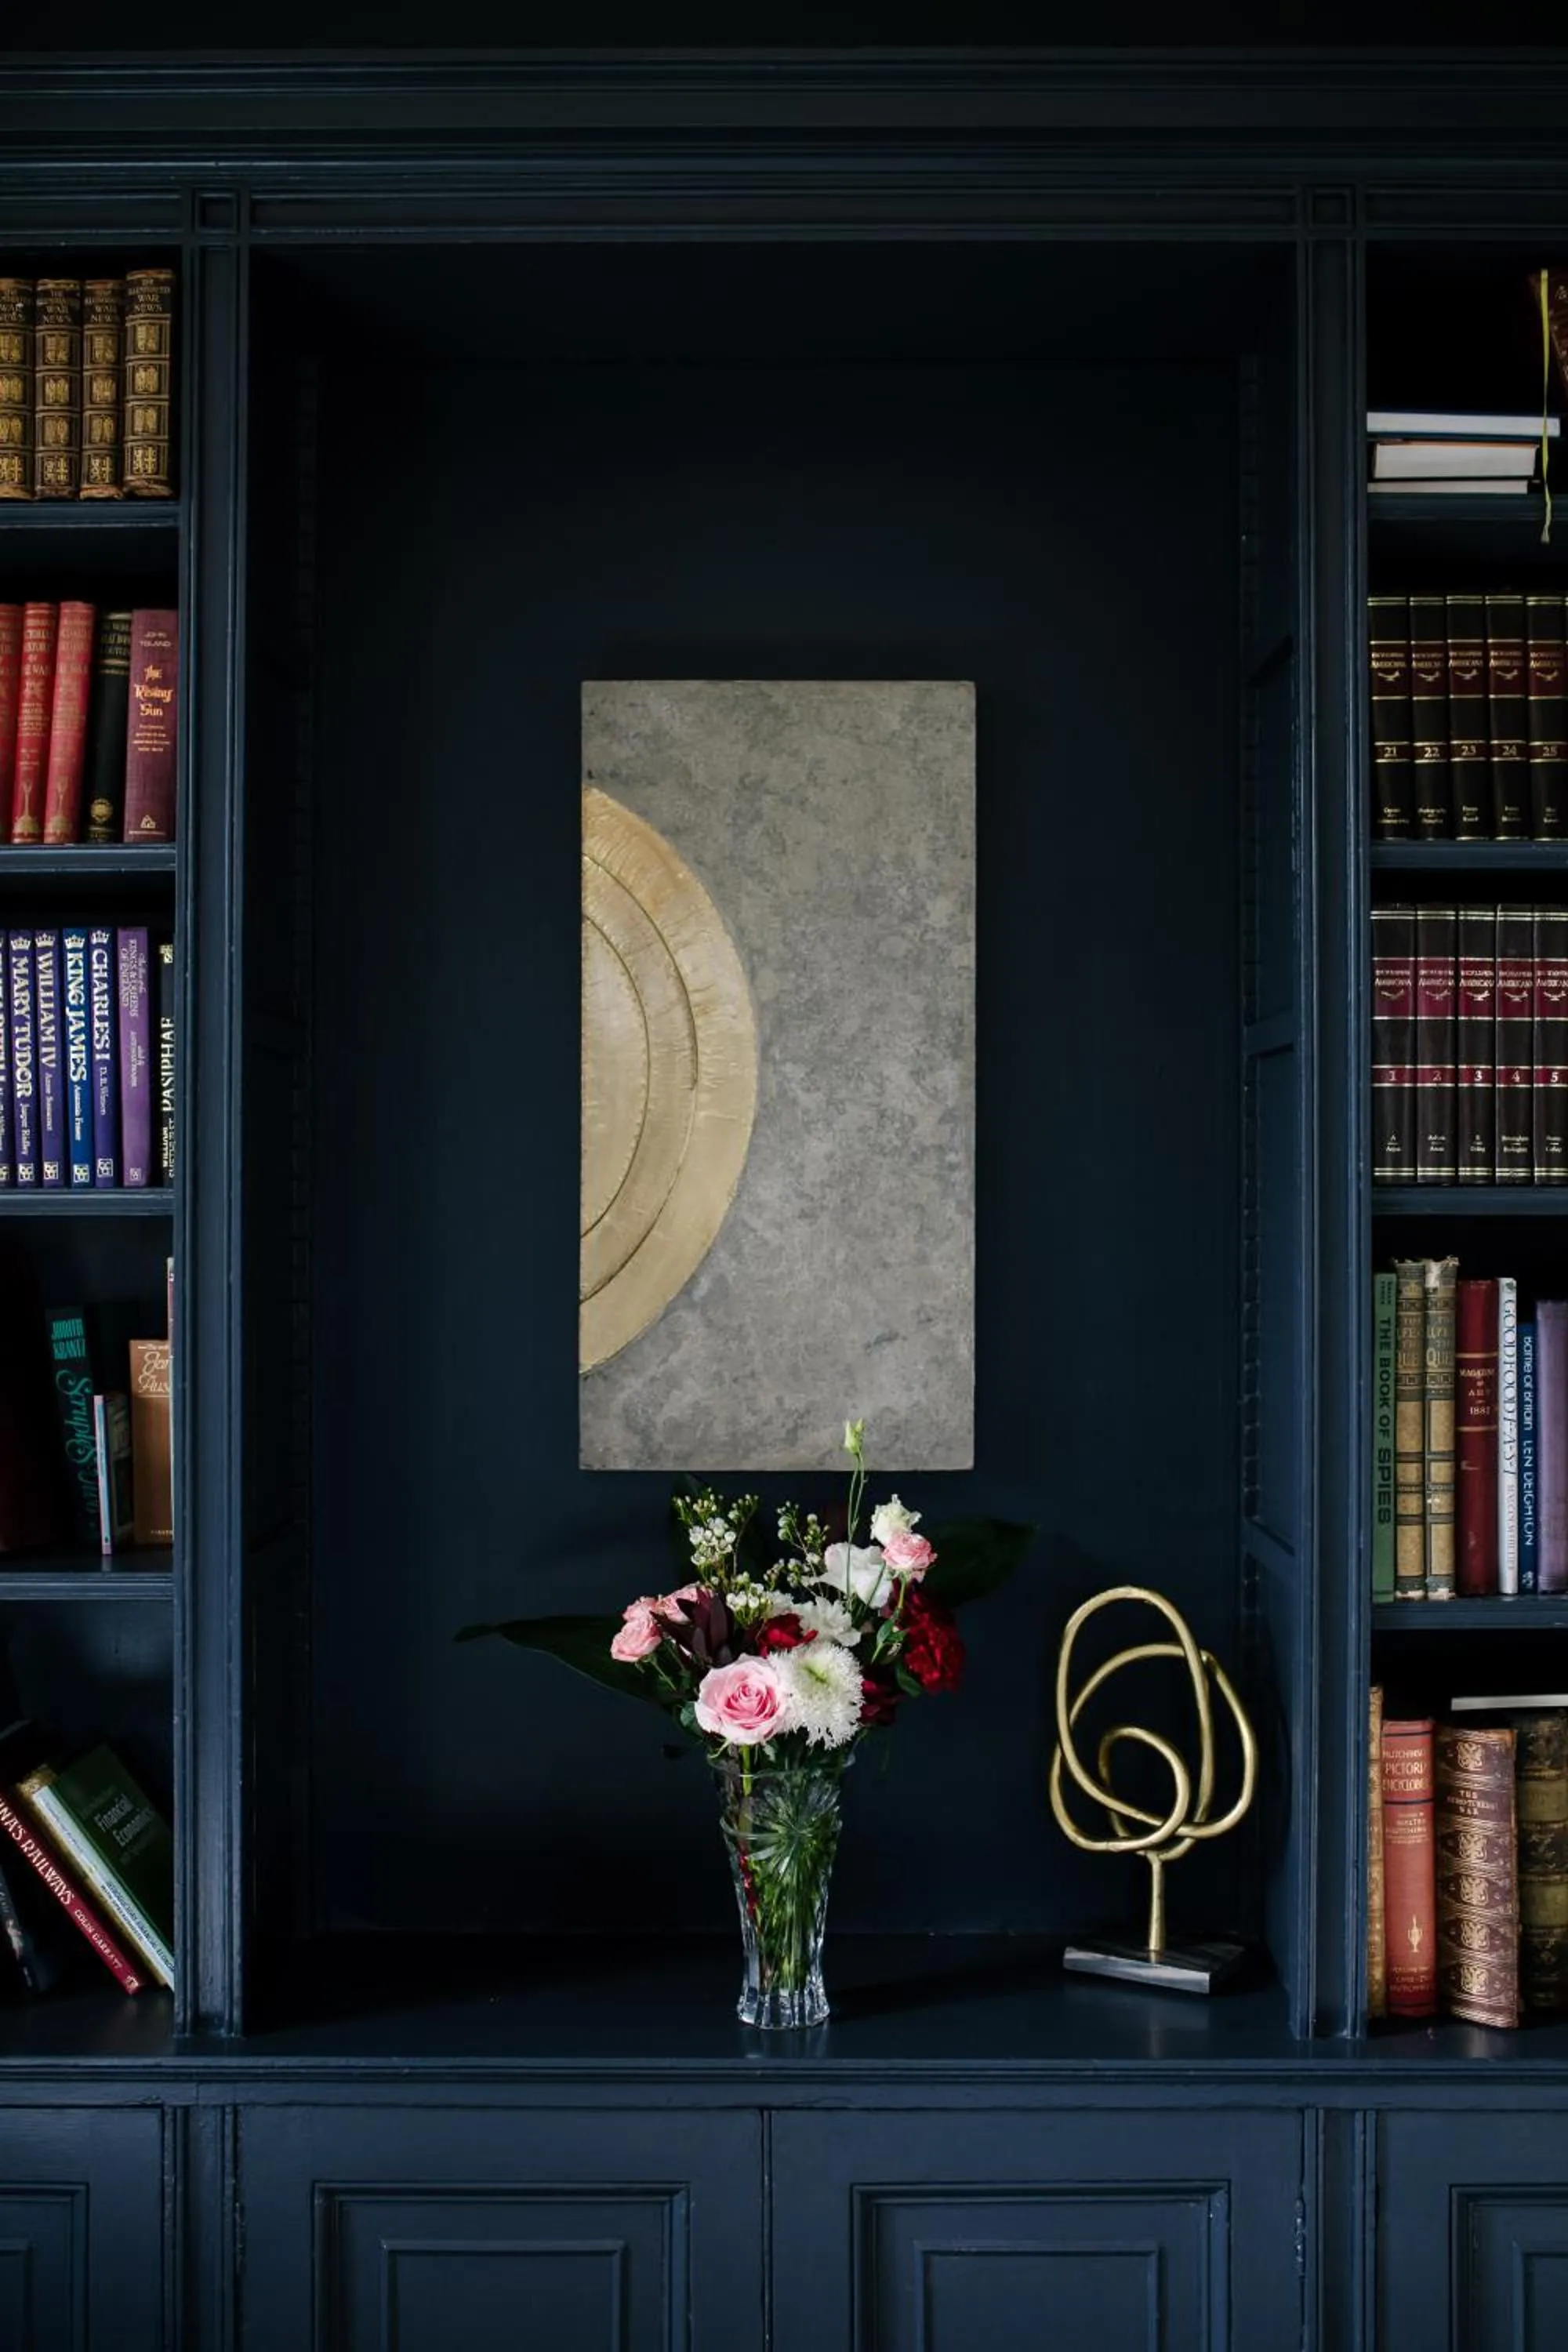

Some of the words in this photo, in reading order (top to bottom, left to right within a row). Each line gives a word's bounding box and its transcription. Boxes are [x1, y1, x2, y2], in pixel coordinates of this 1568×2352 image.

[133, 303, 162, 313] NEWS
[144, 630, 167, 639] JOHN
[134, 684, 173, 703] Rising
[140, 703, 163, 717] Sun
[1384, 746, 1397, 758] 21
[1424, 747, 1440, 758] 22
[1461, 745, 1476, 756] 23
[1501, 746, 1517, 757] 24
[1543, 746, 1557, 757] 25
[12, 956, 31, 1018] MARY
[67, 952, 85, 1004] KING
[37, 951, 56, 1043] WILLIAM
[92, 949, 110, 1051] CHARLES
[65, 1007, 87, 1083] JAMES
[14, 1022, 33, 1098] TUDOR
[41, 1044, 57, 1068] IV
[95, 1053, 111, 1062] I
[1388, 1070, 1396, 1081] 1
[1432, 1070, 1442, 1082] 2
[1474, 1071, 1483, 1082] 3
[1512, 1071, 1520, 1083] 4
[1550, 1072, 1559, 1083] 5
[1379, 1317, 1391, 1348] THE
[1503, 1299, 1516, 1360] GOOD
[1378, 1356, 1391, 1411] BOOK
[1503, 1361, 1516, 1414] FOOD
[1378, 1417, 1391, 1439] OF
[1523, 1439, 1533, 1468] LEN
[1377, 1447, 1392, 1525] SPIES
[1523, 1472, 1534, 1546] DEIGHTON
[1459, 1790, 1478, 1799] THE
[21, 1838, 75, 1906] RAILWAYS
[74, 1907, 94, 1936] COLIN
